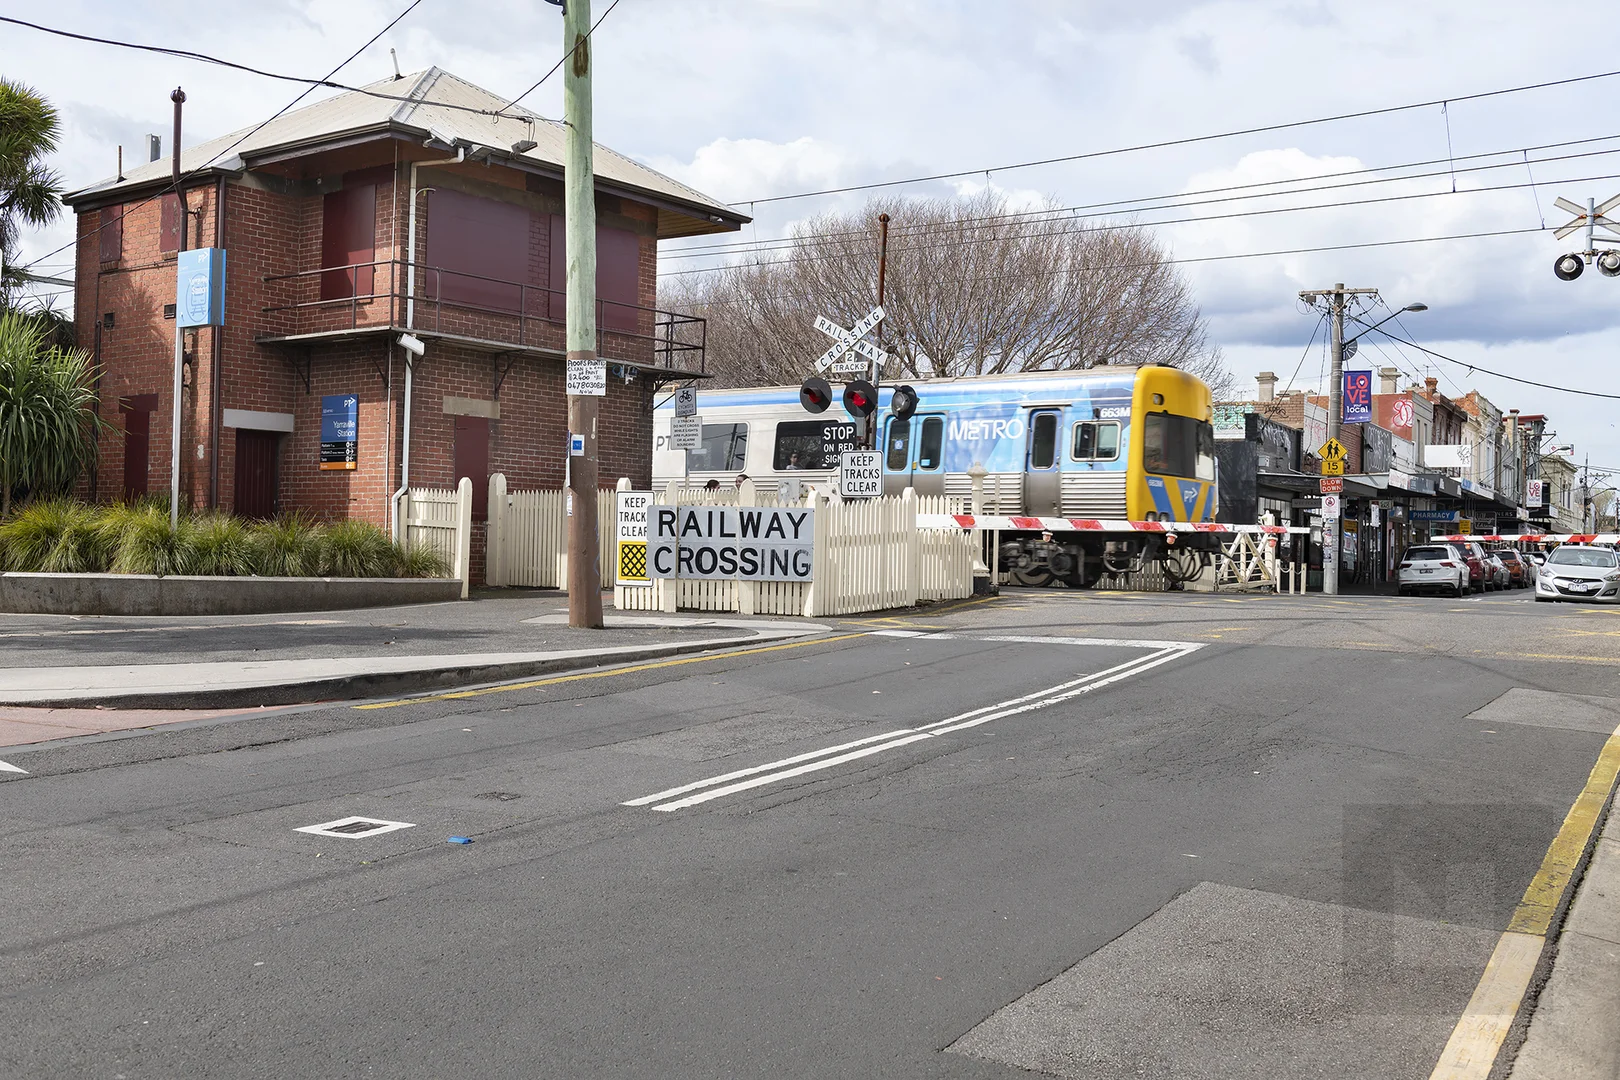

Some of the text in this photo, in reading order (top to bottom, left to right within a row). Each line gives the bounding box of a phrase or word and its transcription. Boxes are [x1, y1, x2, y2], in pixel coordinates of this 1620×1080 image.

[820, 311, 880, 368] CROSSING
[846, 353, 853, 362] 2
[834, 362, 865, 371] TRACKS
[1100, 407, 1131, 418] 663M
[823, 426, 854, 440] STOP
[949, 418, 1024, 440] METRO
[824, 442, 854, 452] ON RED
[850, 456, 874, 466] KEEP
[845, 468, 880, 479] TRACKS
[847, 482, 877, 492] CLEAR
[624, 497, 646, 508] KEEP
[619, 512, 646, 522] TRACK
[658, 510, 808, 539] RAILWAY
[654, 546, 812, 577] CROSSING
